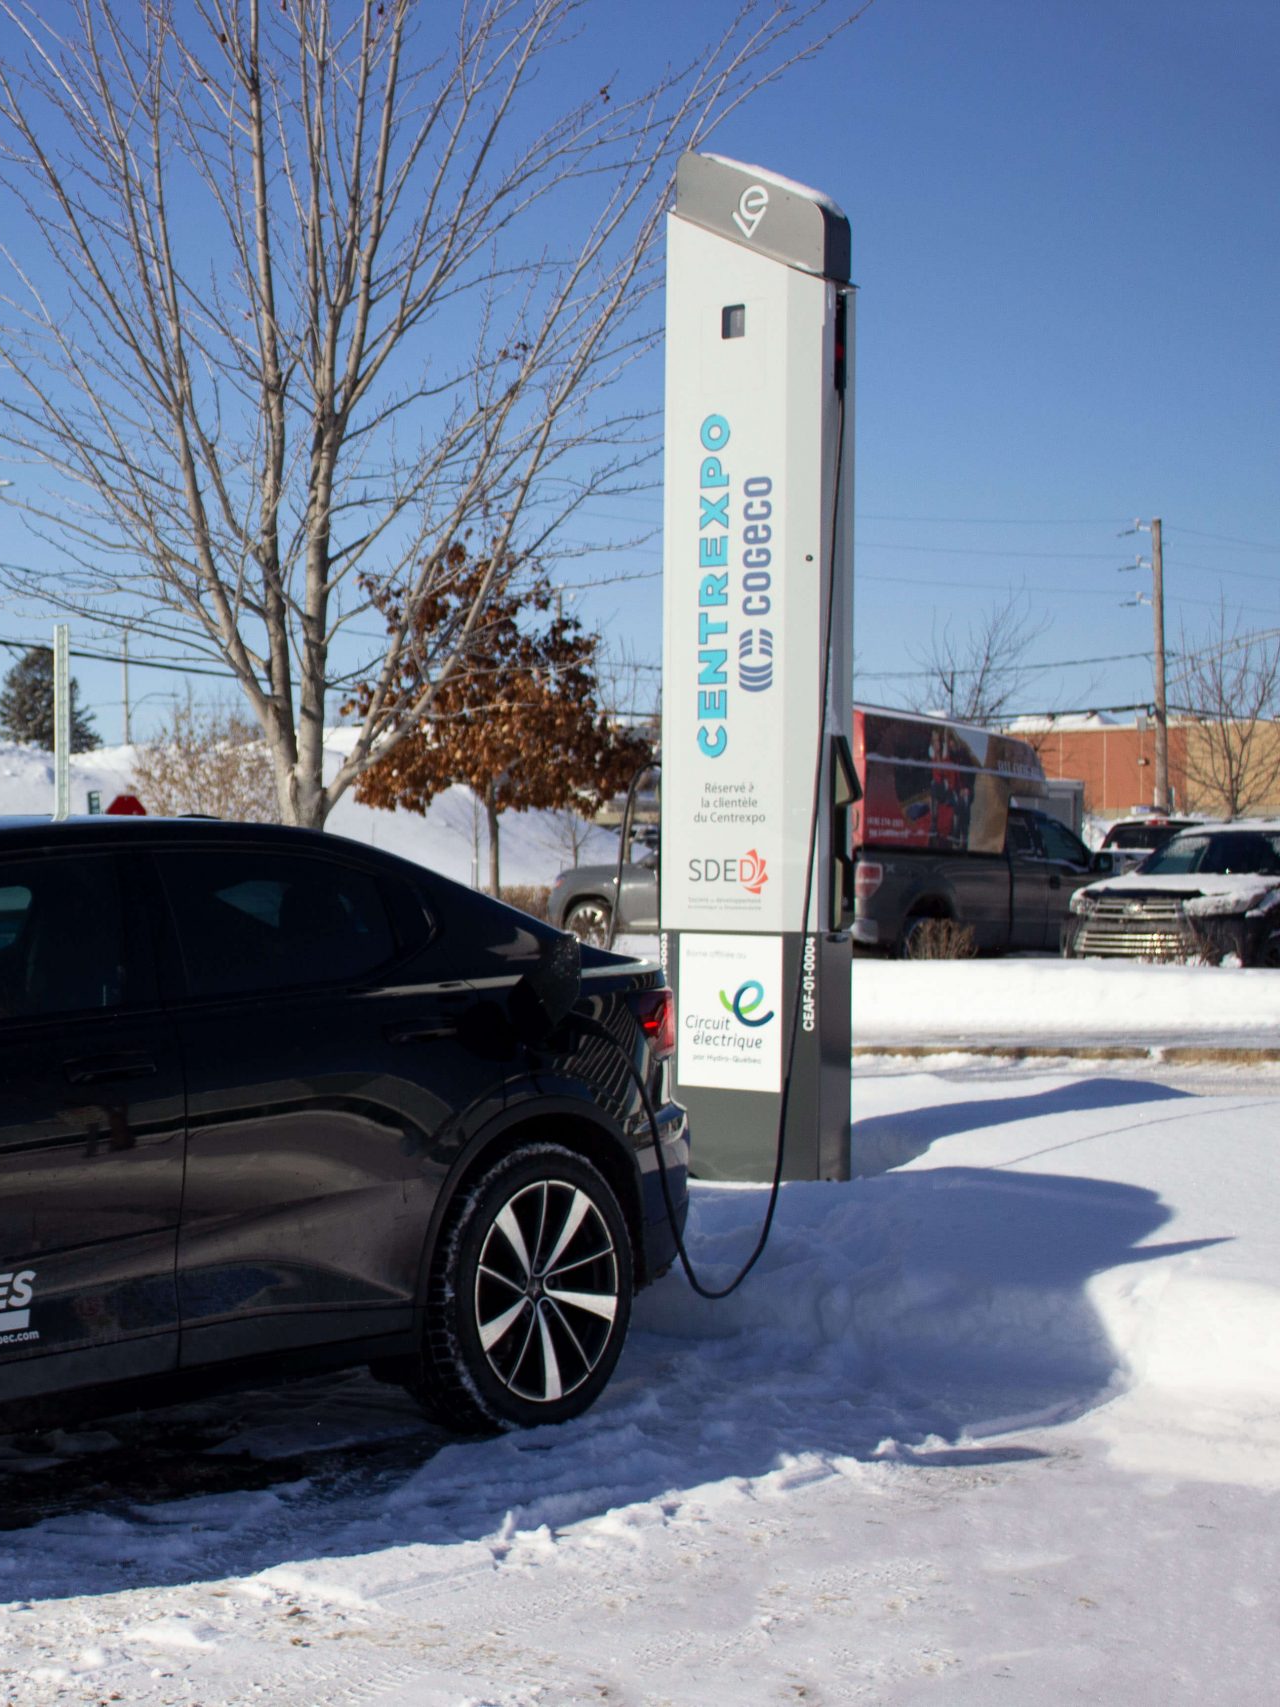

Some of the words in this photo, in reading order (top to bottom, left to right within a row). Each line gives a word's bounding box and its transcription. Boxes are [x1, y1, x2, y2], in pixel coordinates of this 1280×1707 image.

[696, 413, 731, 759] CENTREXPO
[704, 782, 746, 794] Réservé
[701, 797, 710, 808] la
[713, 797, 758, 808] clientèle
[693, 812, 707, 823] du
[710, 811, 766, 825] Centrexpo
[688, 859, 756, 882] SDED
[803, 936, 816, 1031] CEAF-01-0004
[685, 1014, 731, 1031] Circuit
[693, 1030, 763, 1050] électrique
